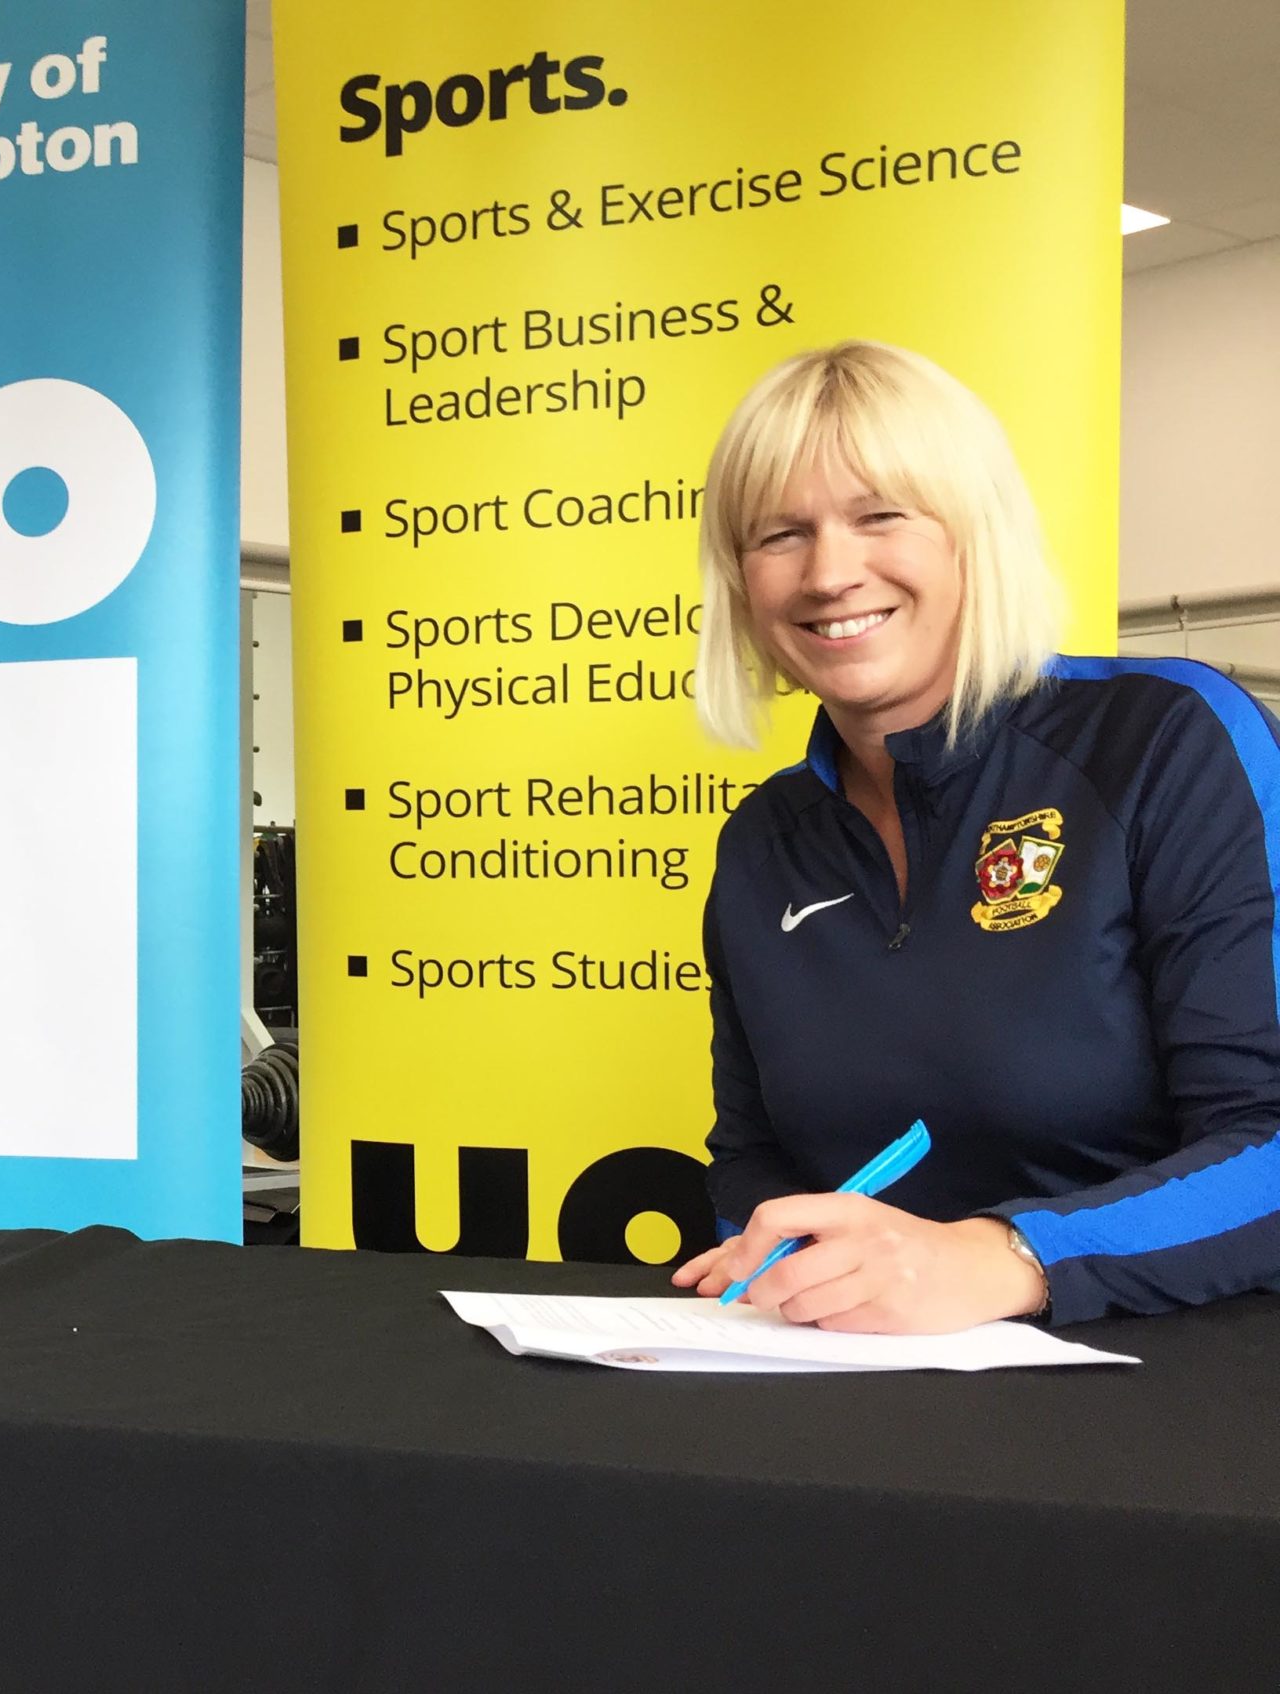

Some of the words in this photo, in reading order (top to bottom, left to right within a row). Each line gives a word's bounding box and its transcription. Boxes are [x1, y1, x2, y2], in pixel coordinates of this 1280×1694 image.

[29, 35, 108, 100] of
[339, 51, 628, 158] Sports.
[382, 201, 530, 260] Sports
[547, 189, 583, 231] &
[601, 167, 807, 226] Exercise
[820, 141, 1021, 196] Science
[383, 316, 507, 374] Sport
[525, 298, 739, 350] Business
[756, 284, 794, 327] &
[385, 368, 645, 426] Leadership
[385, 495, 508, 548] Sport
[386, 609, 532, 659] Sports
[389, 662, 569, 720] Physical
[389, 781, 511, 830] Sport
[390, 837, 689, 890] Conditioning
[391, 949, 536, 999] Sports
[552, 950, 713, 993] Studie
